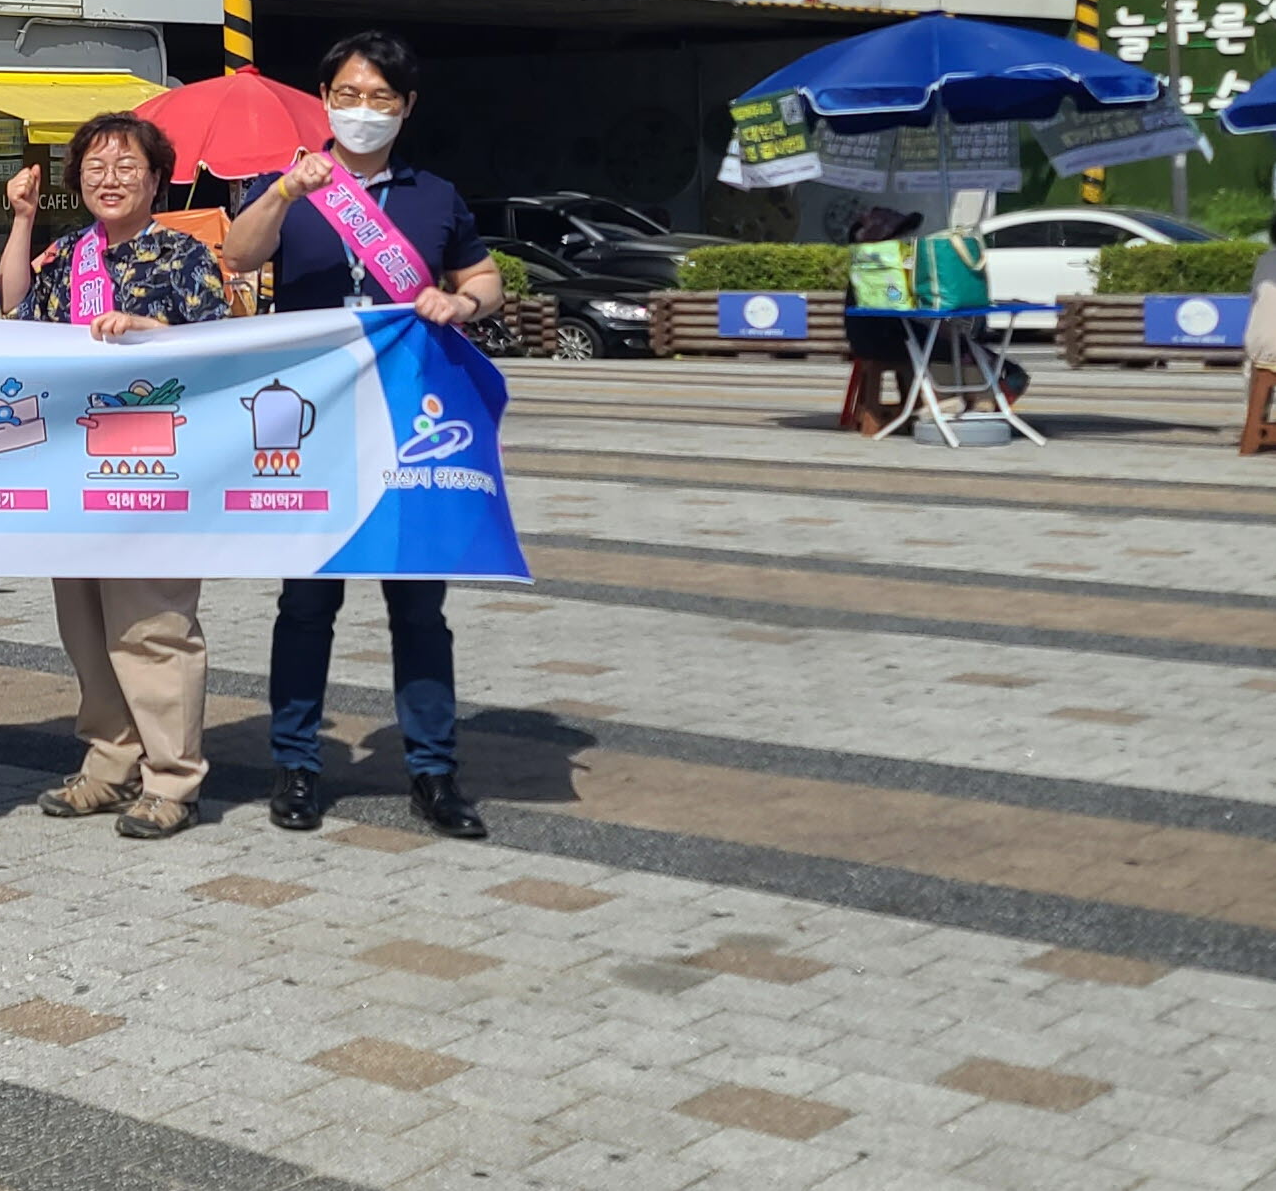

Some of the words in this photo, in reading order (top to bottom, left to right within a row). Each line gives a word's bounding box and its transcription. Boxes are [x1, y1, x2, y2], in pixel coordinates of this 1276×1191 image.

[2, 194, 12, 210] U
[38, 194, 68, 210] CAFE
[70, 192, 80, 209] U
[382, 469, 431, 488] 안산시
[138, 492, 167, 510] 먹기
